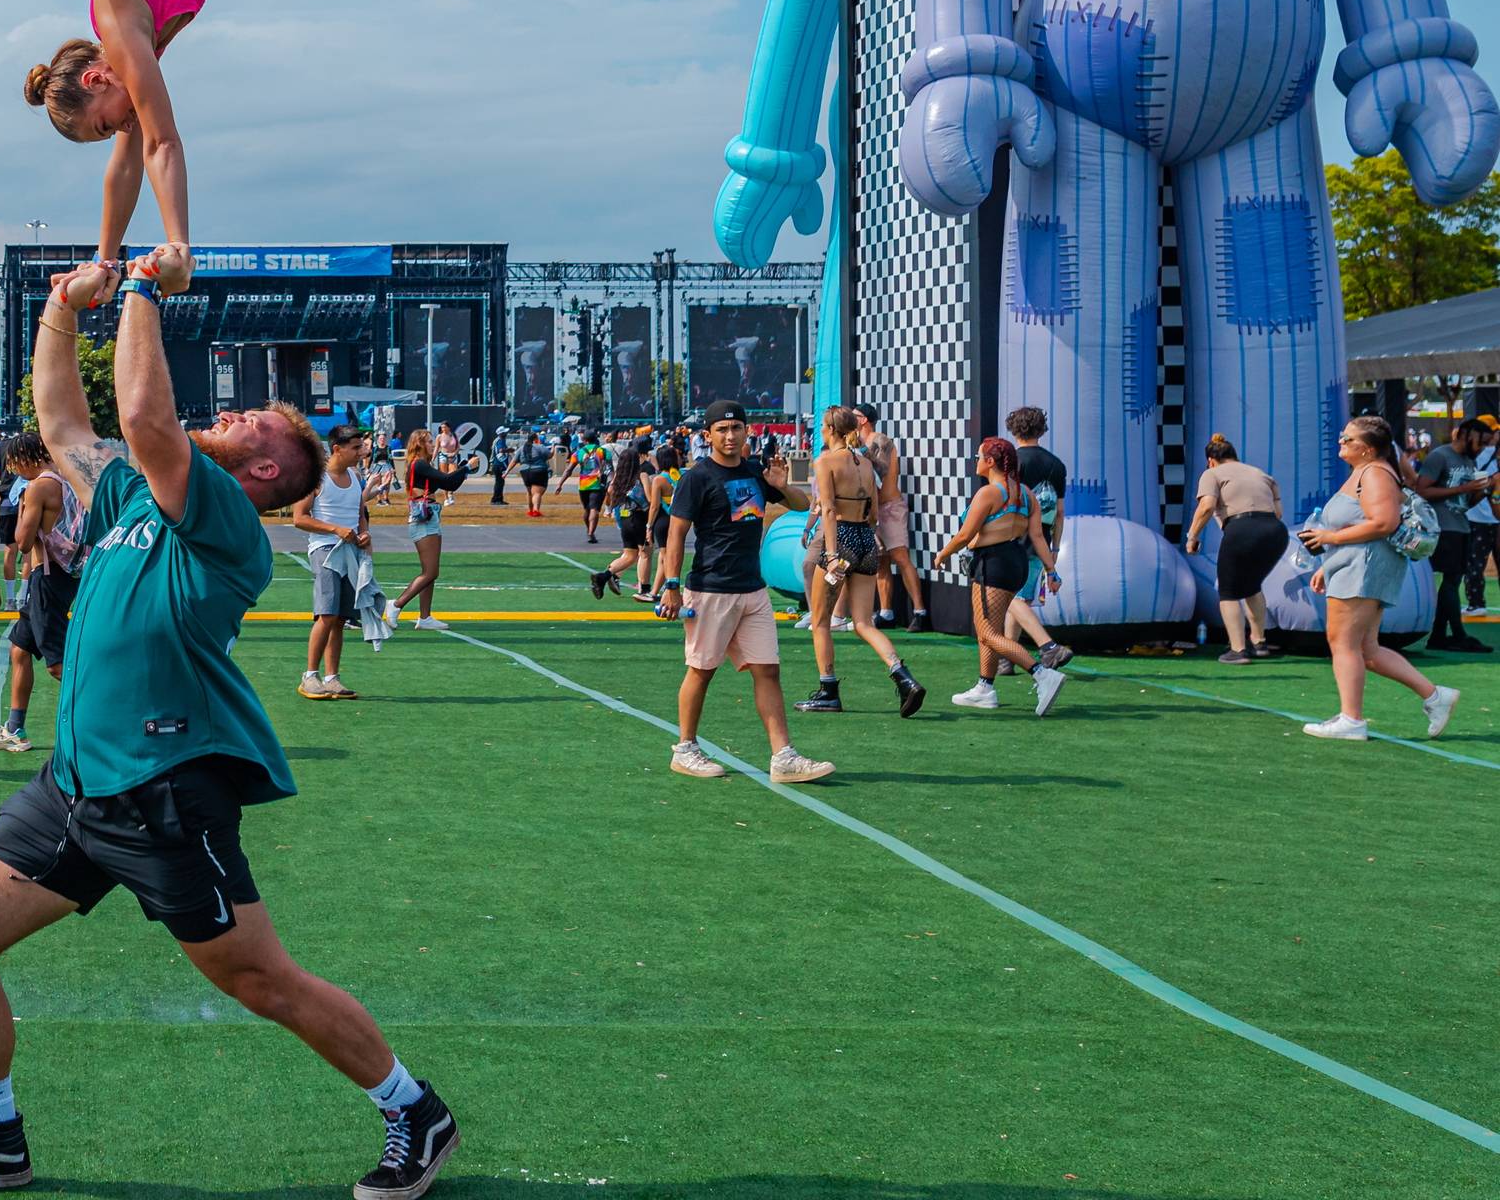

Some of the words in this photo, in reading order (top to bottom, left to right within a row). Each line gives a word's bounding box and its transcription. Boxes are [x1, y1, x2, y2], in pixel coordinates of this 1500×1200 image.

[264, 254, 330, 270] STAGE
[216, 364, 234, 374] 956
[311, 361, 328, 370] 956
